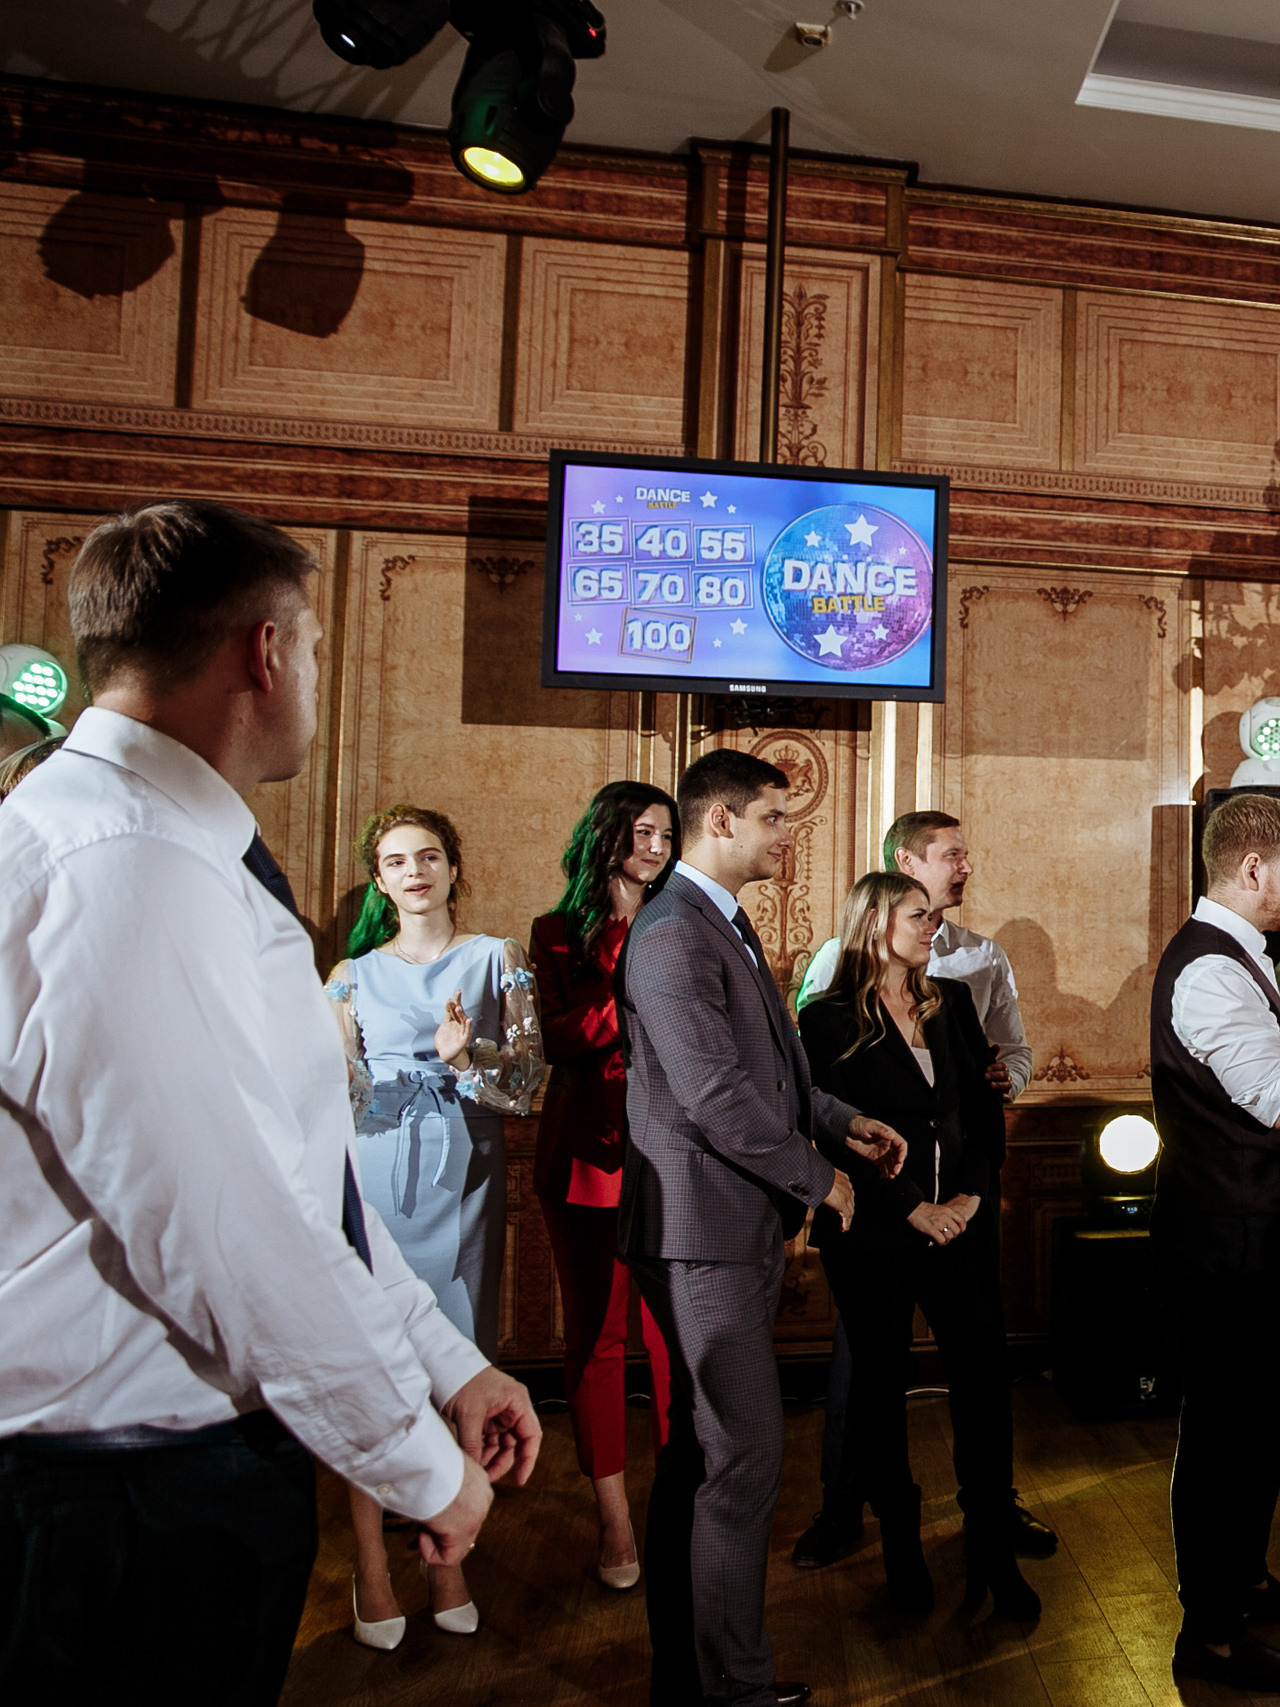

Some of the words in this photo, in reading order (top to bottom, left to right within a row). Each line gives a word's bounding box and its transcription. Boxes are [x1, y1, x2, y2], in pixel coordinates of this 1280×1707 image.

[635, 487, 691, 503] DANCE
[577, 522, 624, 554] 35
[637, 526, 687, 558] 40
[700, 530, 746, 561] 55
[574, 568, 624, 600] 65
[637, 572, 685, 603] 70
[698, 575, 745, 606] 80
[782, 559, 917, 596] DANCE
[812, 595, 886, 613] BATTLE
[626, 619, 691, 652] 100
[729, 684, 767, 693] SAMSUNG
